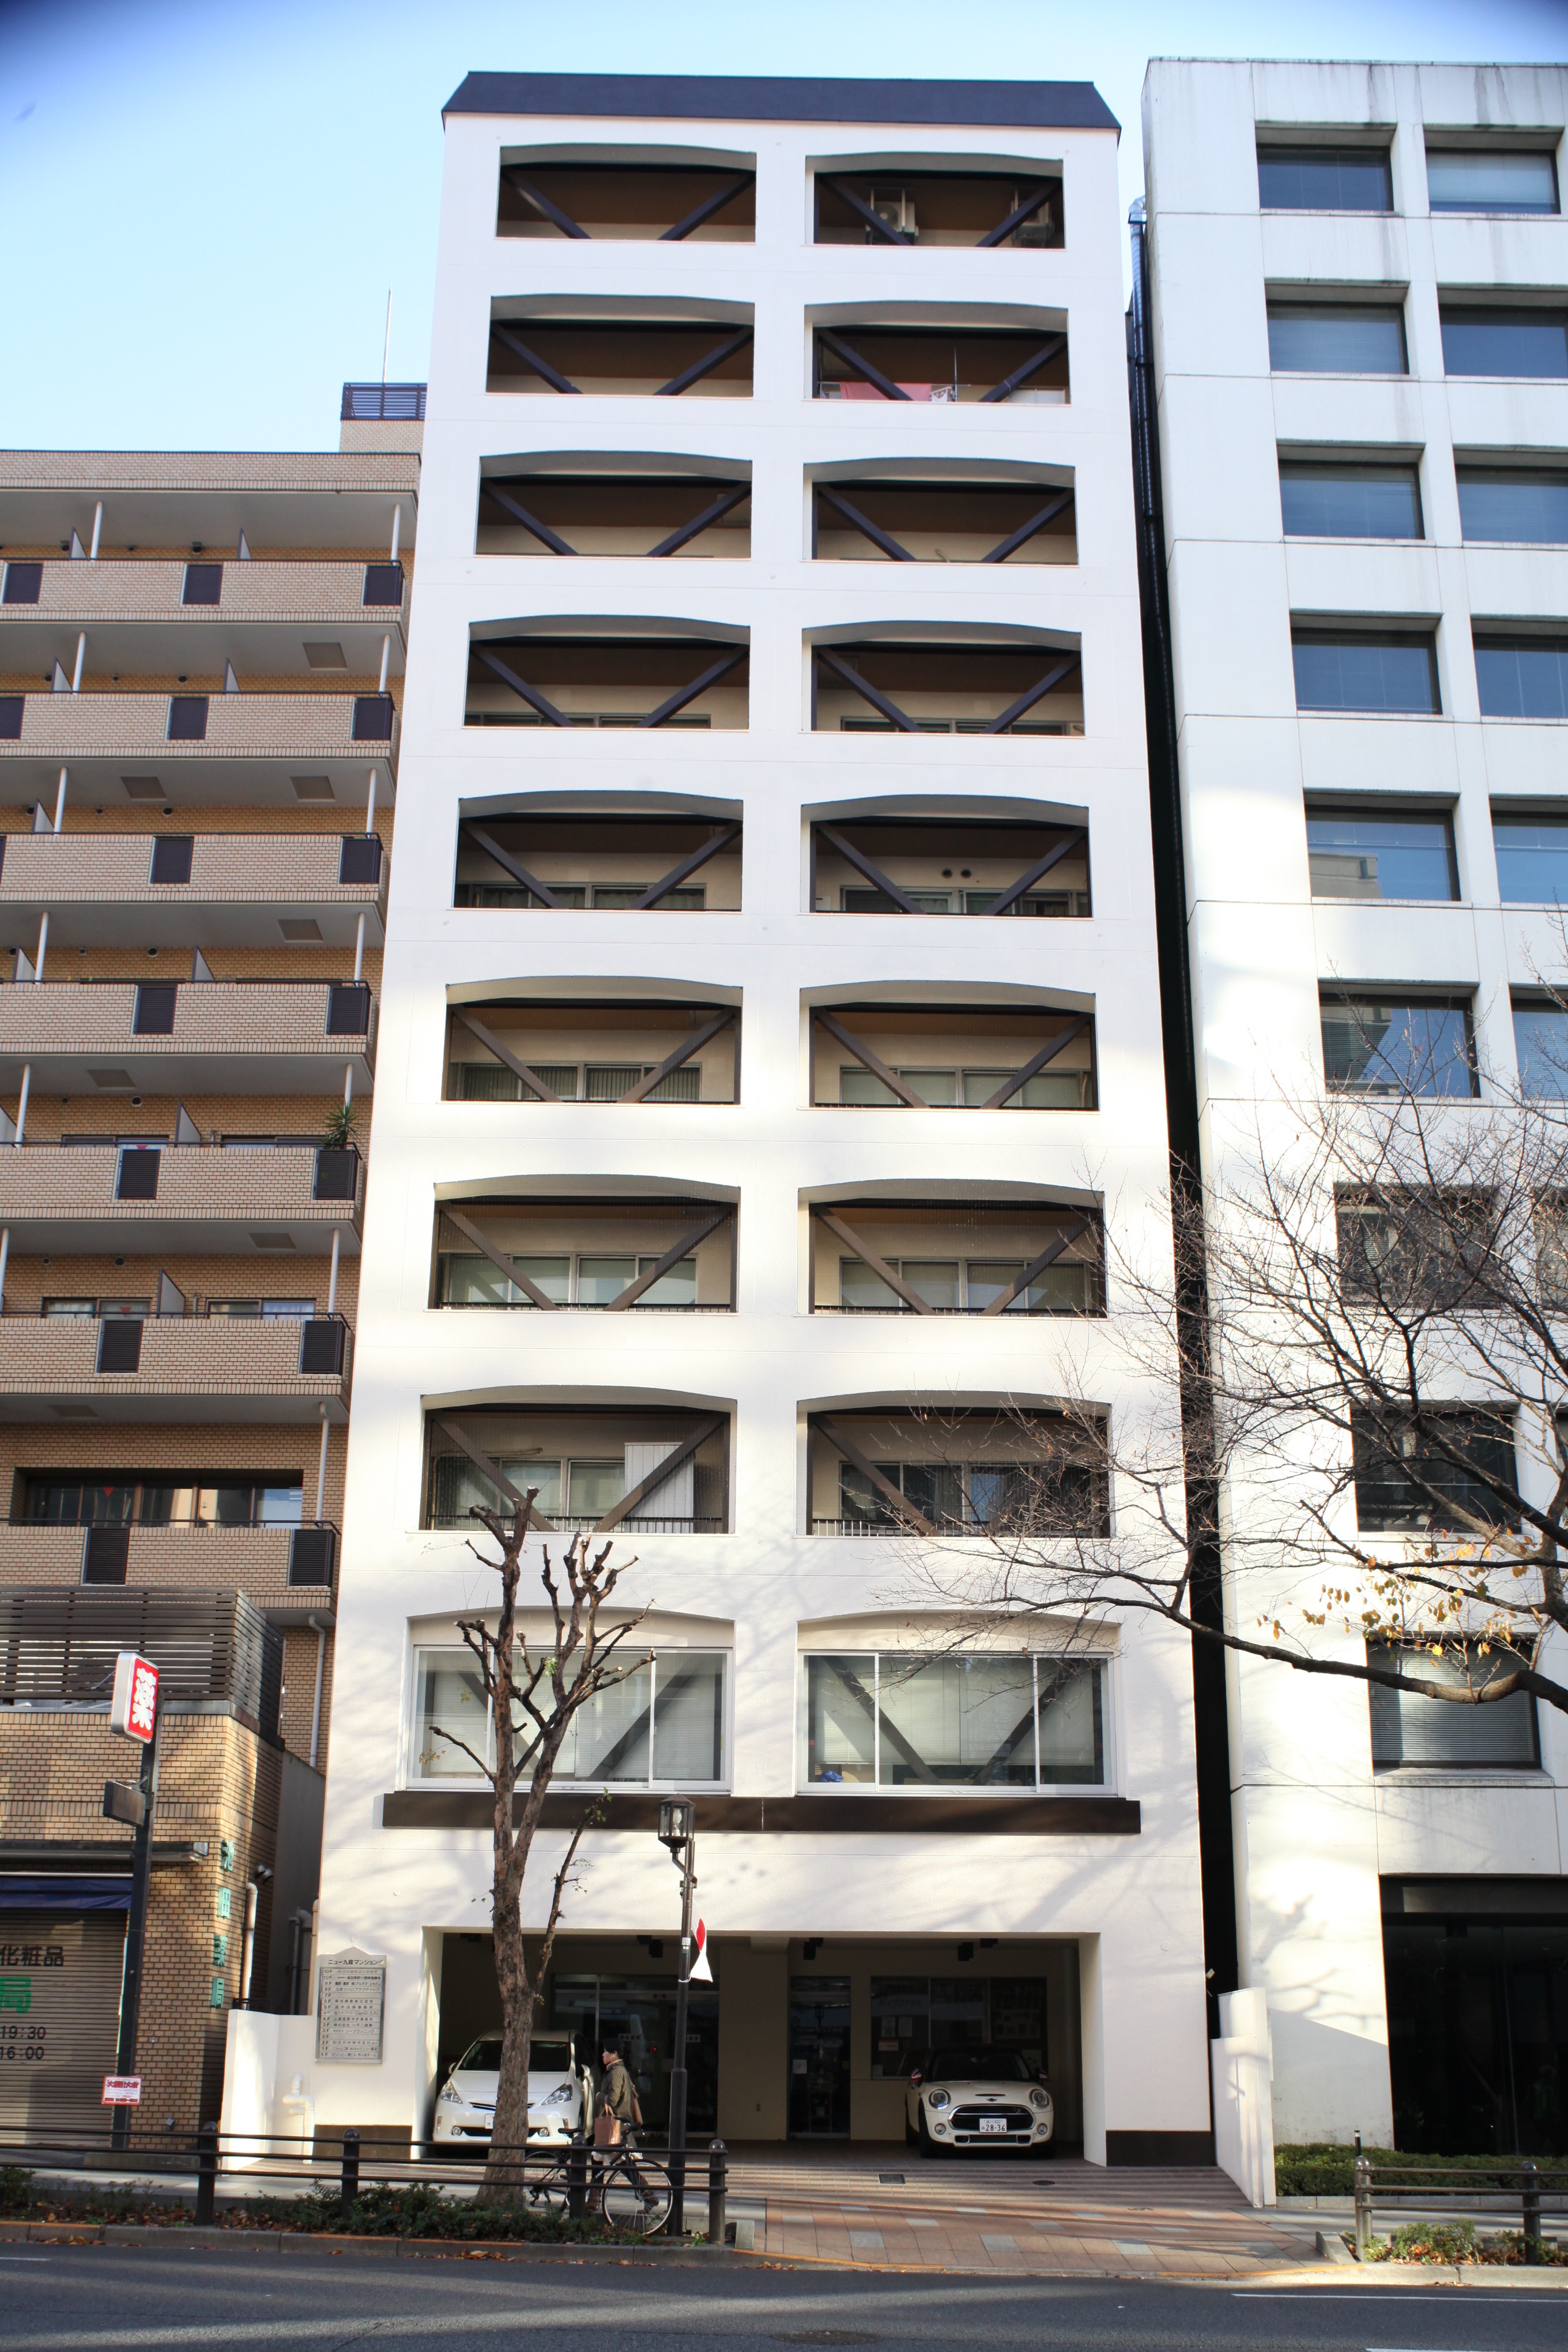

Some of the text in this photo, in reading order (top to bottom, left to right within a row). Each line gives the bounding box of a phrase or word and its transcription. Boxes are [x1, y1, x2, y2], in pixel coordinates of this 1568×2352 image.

[132, 1667, 156, 1731] 薬
[0, 1946, 63, 1966] 化粧品
[0, 1976, 31, 2013] 局
[1, 2025, 46, 2039] 19:30
